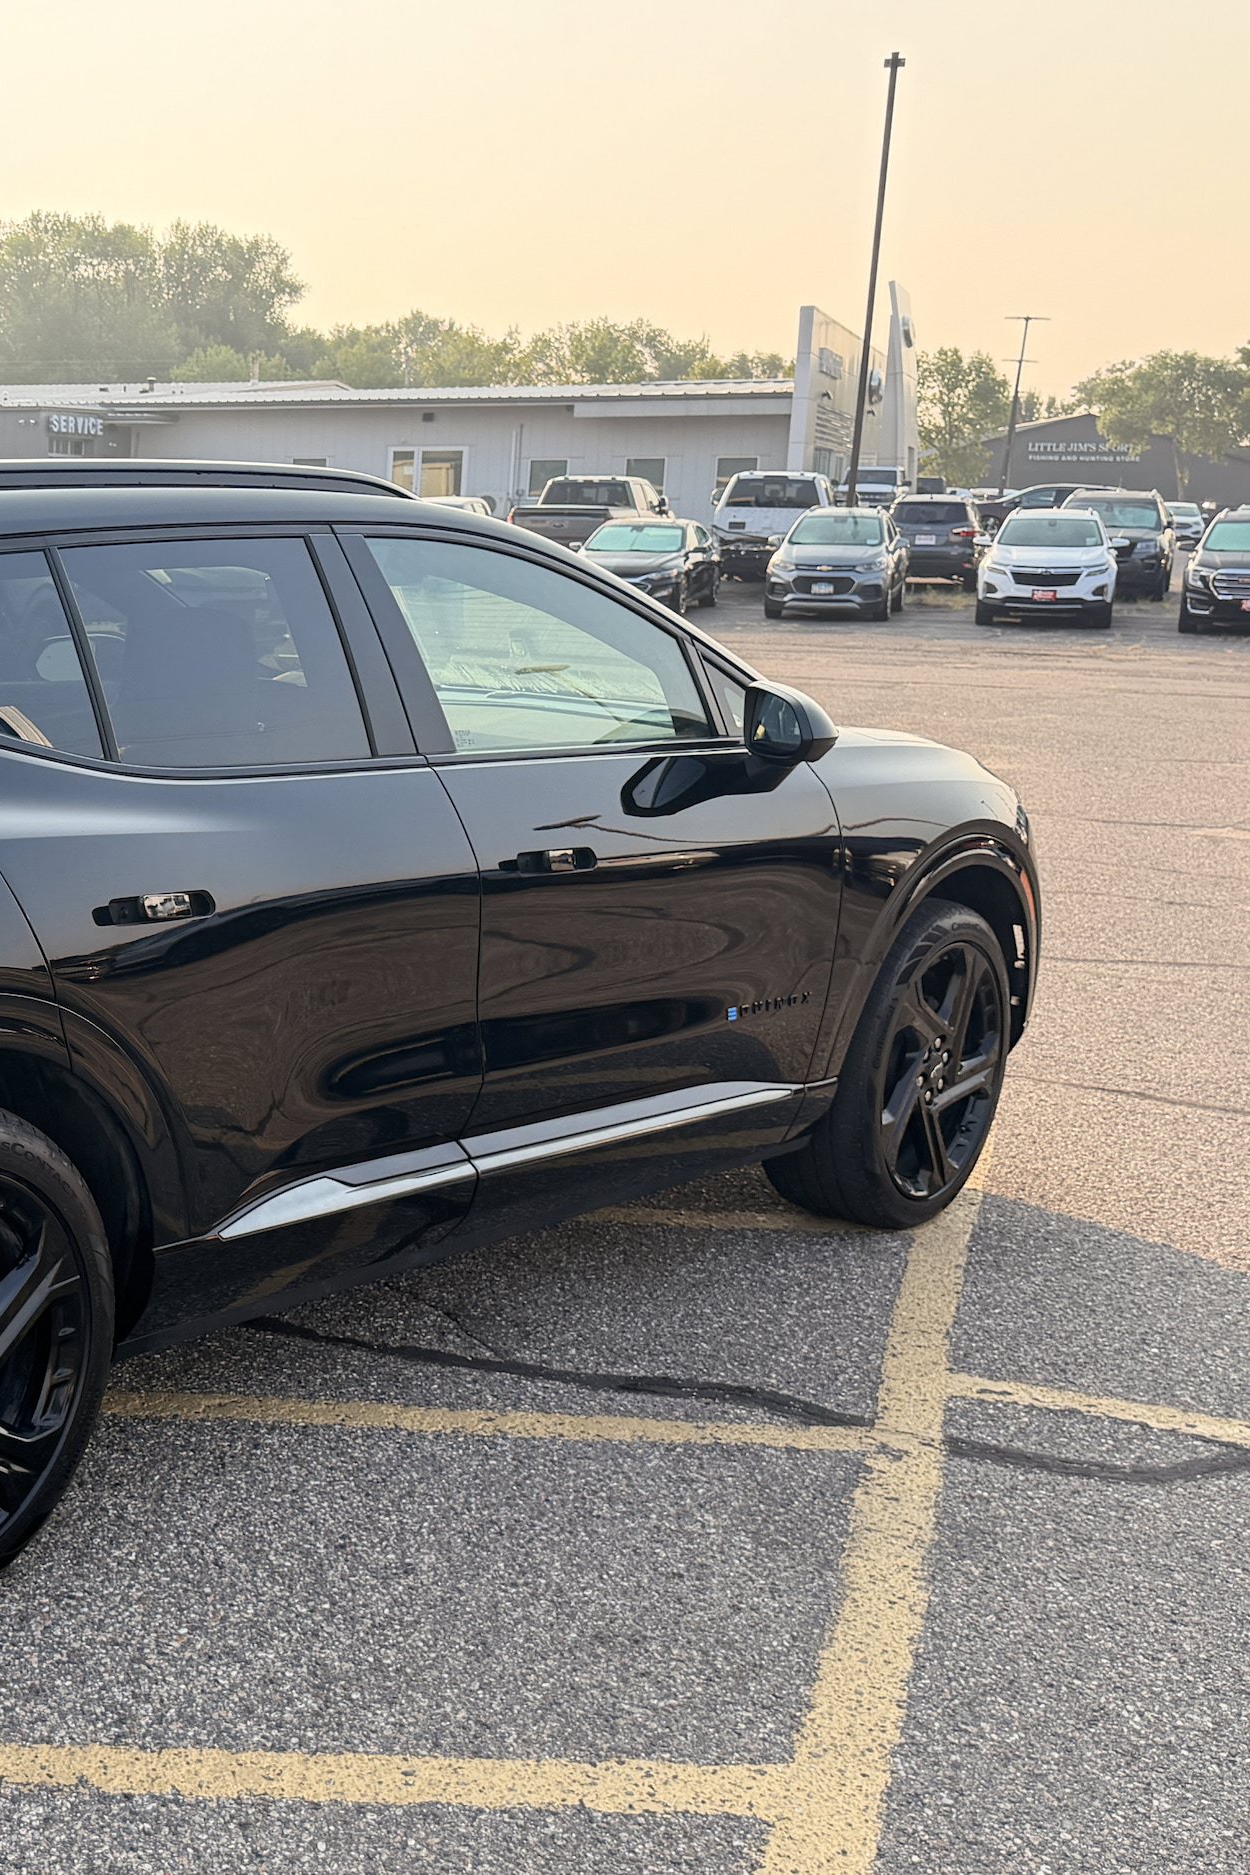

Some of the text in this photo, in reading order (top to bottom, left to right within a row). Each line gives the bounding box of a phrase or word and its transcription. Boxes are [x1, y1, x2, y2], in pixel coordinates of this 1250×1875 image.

[49, 414, 104, 436] SERVICE
[1028, 442, 1141, 454] LITTLE JIM'S SORT
